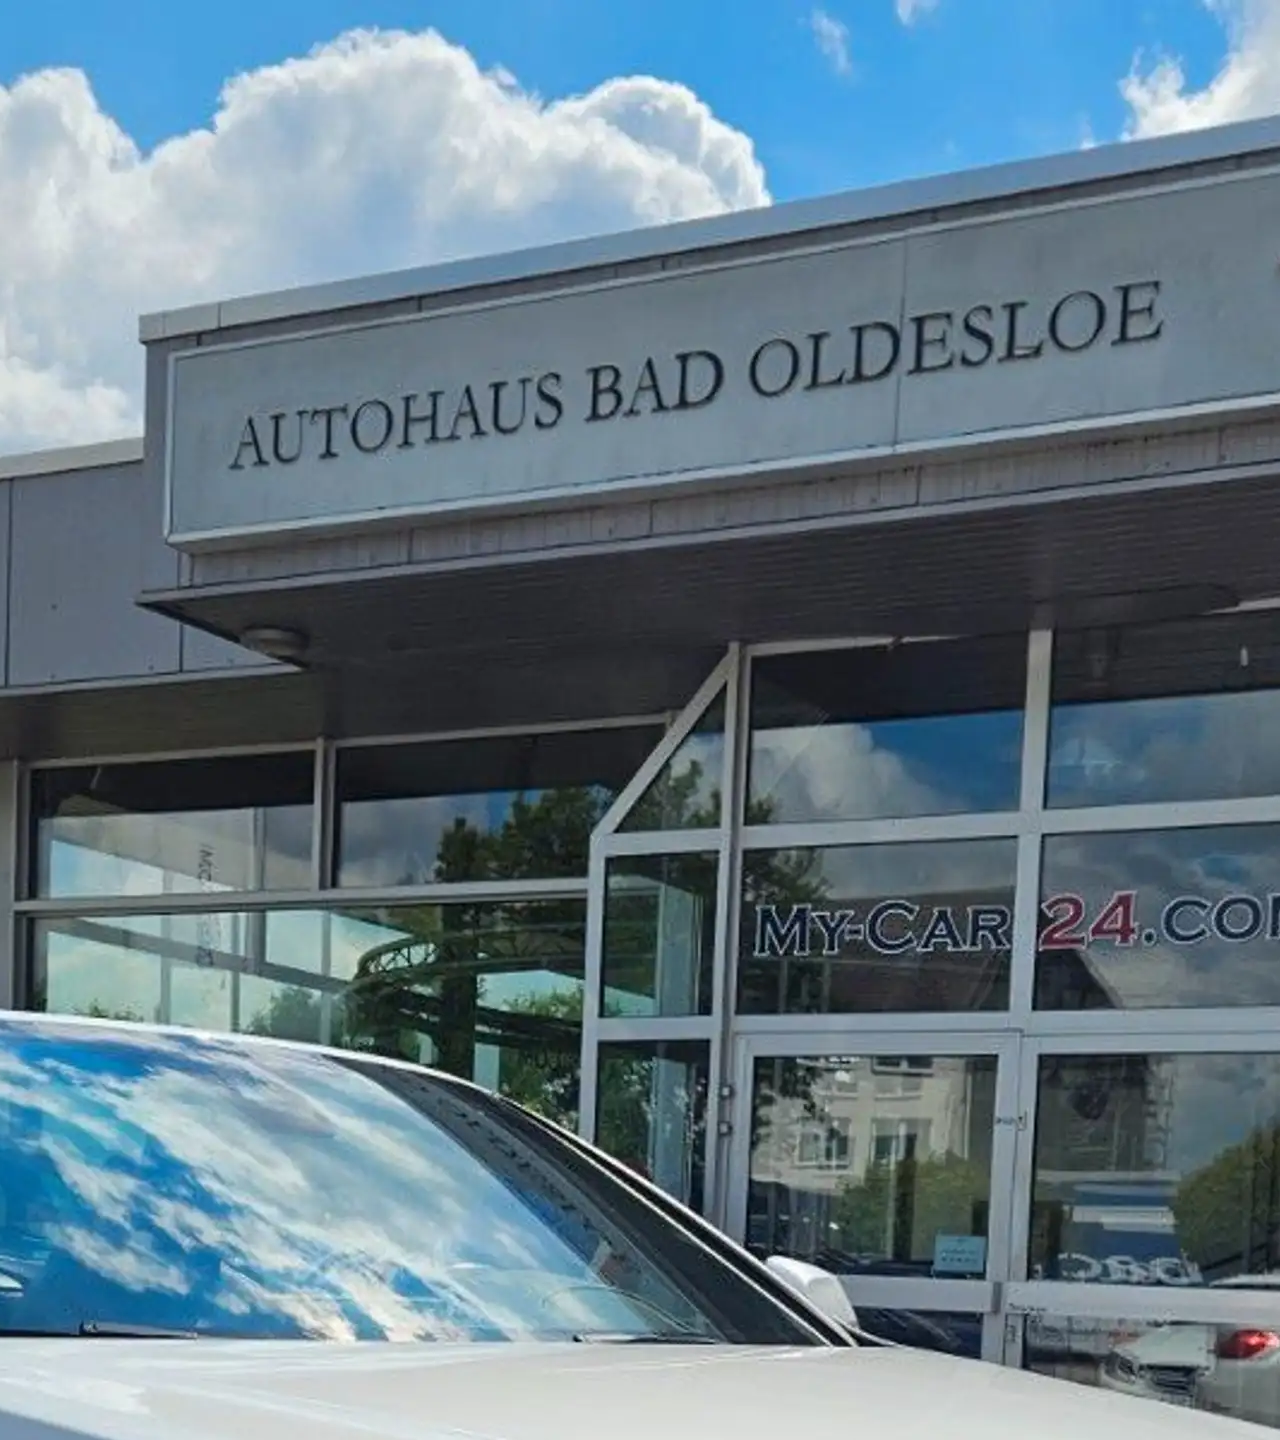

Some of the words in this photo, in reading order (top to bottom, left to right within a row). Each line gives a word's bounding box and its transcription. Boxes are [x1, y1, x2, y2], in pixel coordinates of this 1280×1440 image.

[228, 370, 565, 472] AUTOHAUS
[584, 347, 723, 424] BAD
[748, 280, 1164, 399] OLDESLOE
